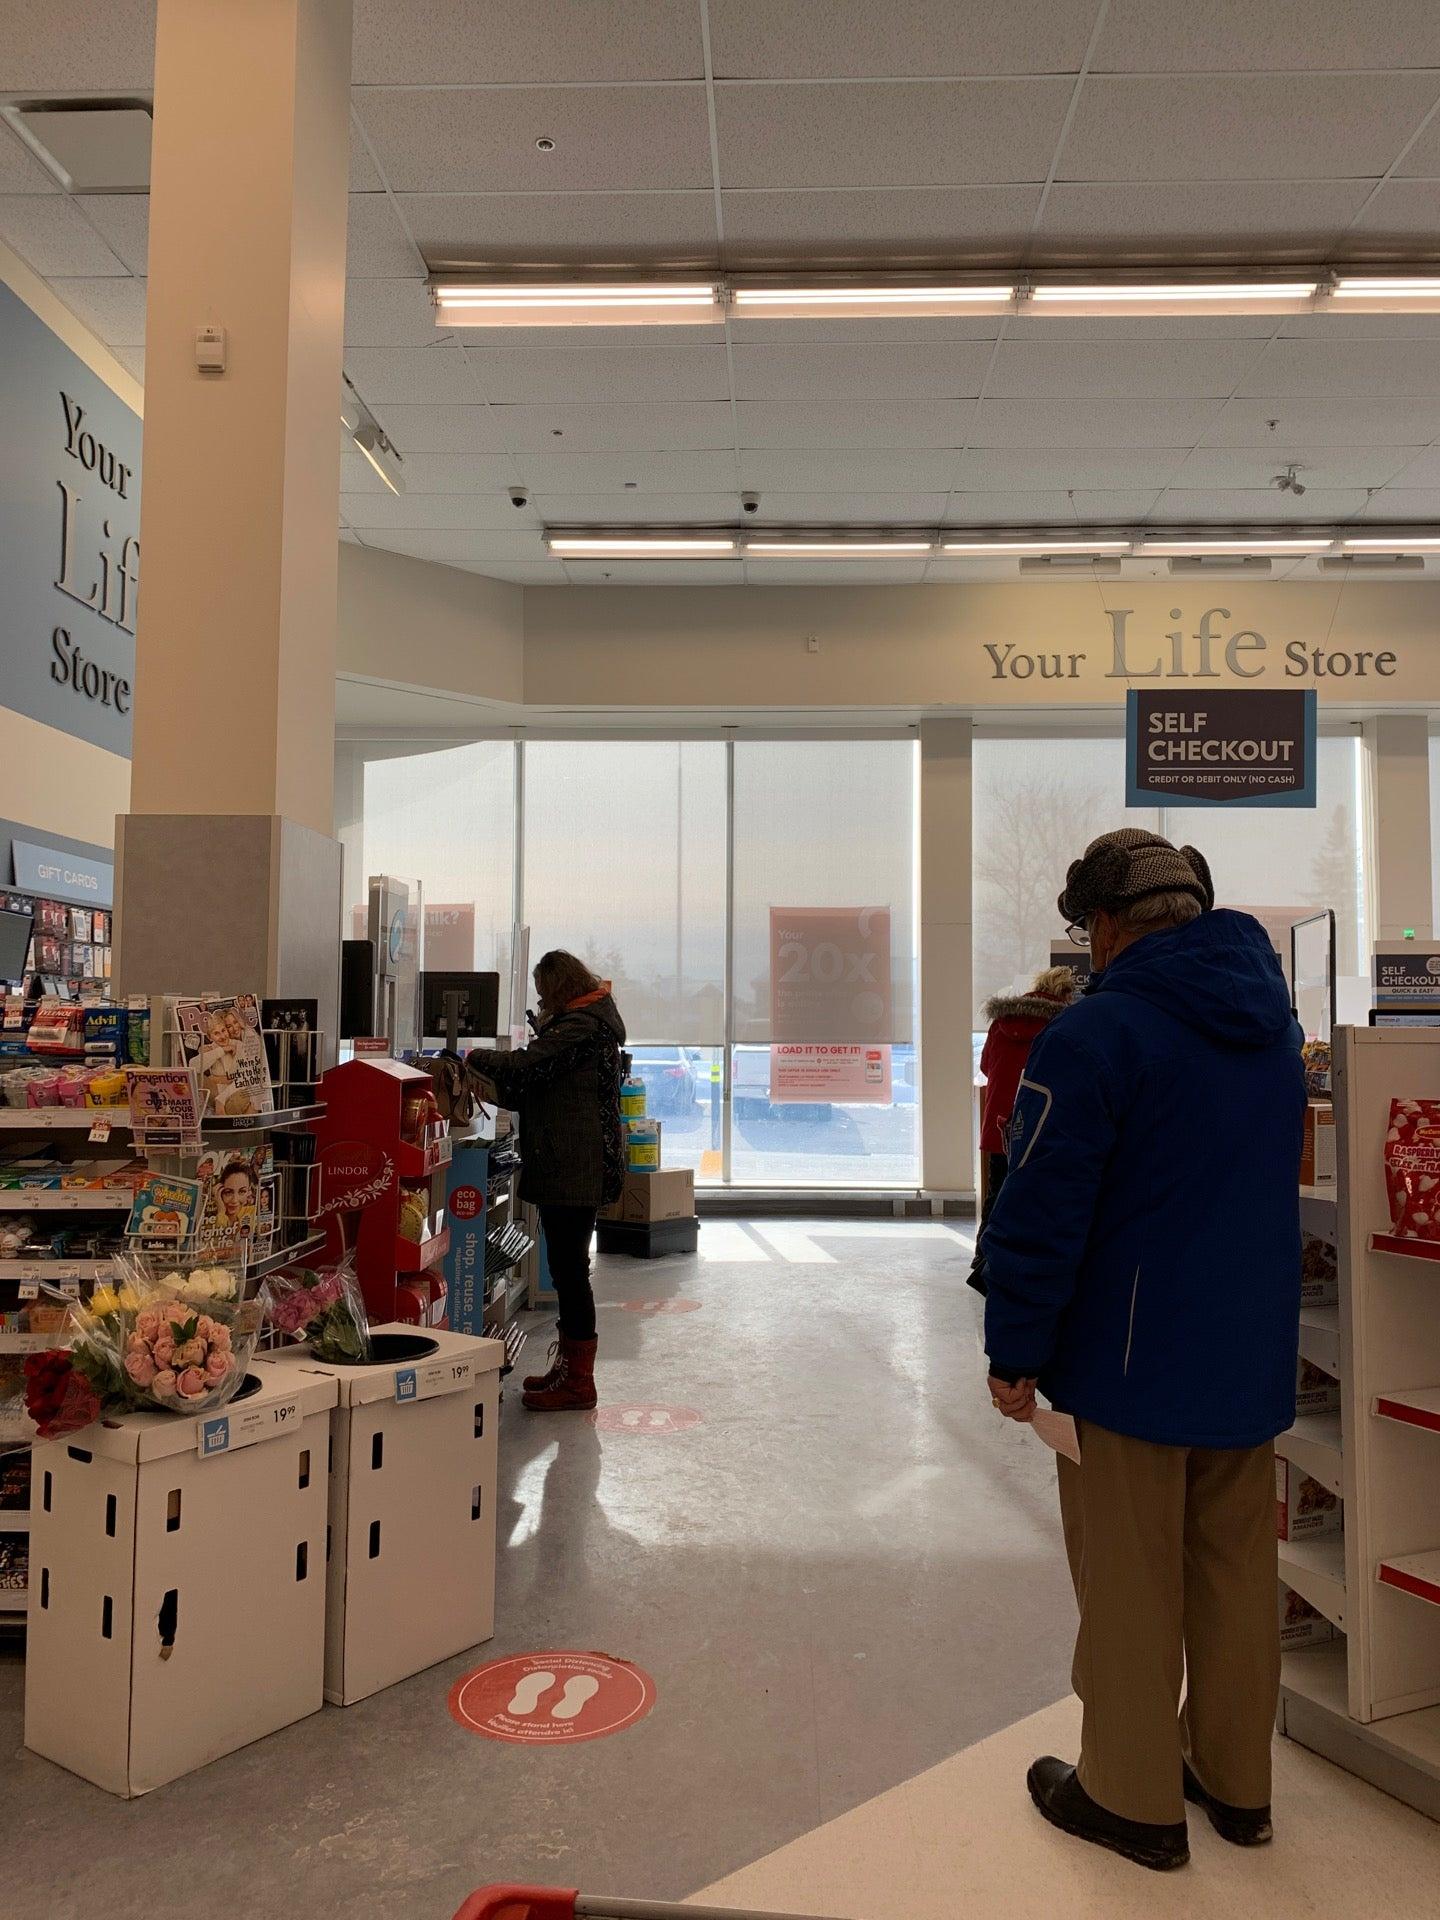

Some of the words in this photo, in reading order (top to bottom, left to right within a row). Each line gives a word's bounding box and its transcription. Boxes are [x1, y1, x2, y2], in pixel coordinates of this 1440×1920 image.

[60, 391, 132, 499] Your
[54, 480, 139, 636] Lif
[983, 642, 1086, 679] Your
[1104, 607, 1267, 678] Life
[1284, 641, 1397, 677] Store
[51, 626, 131, 714] Store
[1148, 712, 1207, 733] SELF
[1148, 740, 1294, 761] CHECKOUT
[1148, 775, 1180, 784] CREDIT
[1181, 775, 1194, 784] OR
[1196, 775, 1221, 784] DEBIT
[1223, 775, 1247, 784] ONLY
[1248, 774, 1266, 785] (NO
[1267, 774, 1295, 785] CASH)
[38, 864, 62, 882] GIFT
[64, 870, 98, 889] CARDS
[778, 942, 879, 983] 20x
[1381, 966, 1406, 975] SELF
[87, 1015, 118, 1025] Advil
[777, 1046, 803, 1054] LOAD
[805, 1046, 814, 1054] IT
[815, 1046, 829, 1054] TO
[830, 1046, 846, 1054] GET
[126, 1072, 188, 1084] Prevention
[226, 1069, 245, 1081] Lucky
[246, 1069, 252, 1077] to
[253, 1066, 267, 1075] Hae
[234, 1078, 249, 1088] Each
[328, 1166, 369, 1176] LINDOR
[456, 1190, 476, 1199] eco
[456, 1199, 476, 1210] bag
[201, 1224, 225, 1242] ight
[226, 1222, 241, 1236] of
[462, 1233, 477, 1269] shop.
[463, 1275, 474, 1316] reuse.
[532, 1658, 562, 1666] Social
[564, 1658, 611, 1672] Distancing
[495, 1713, 521, 1726] Please
